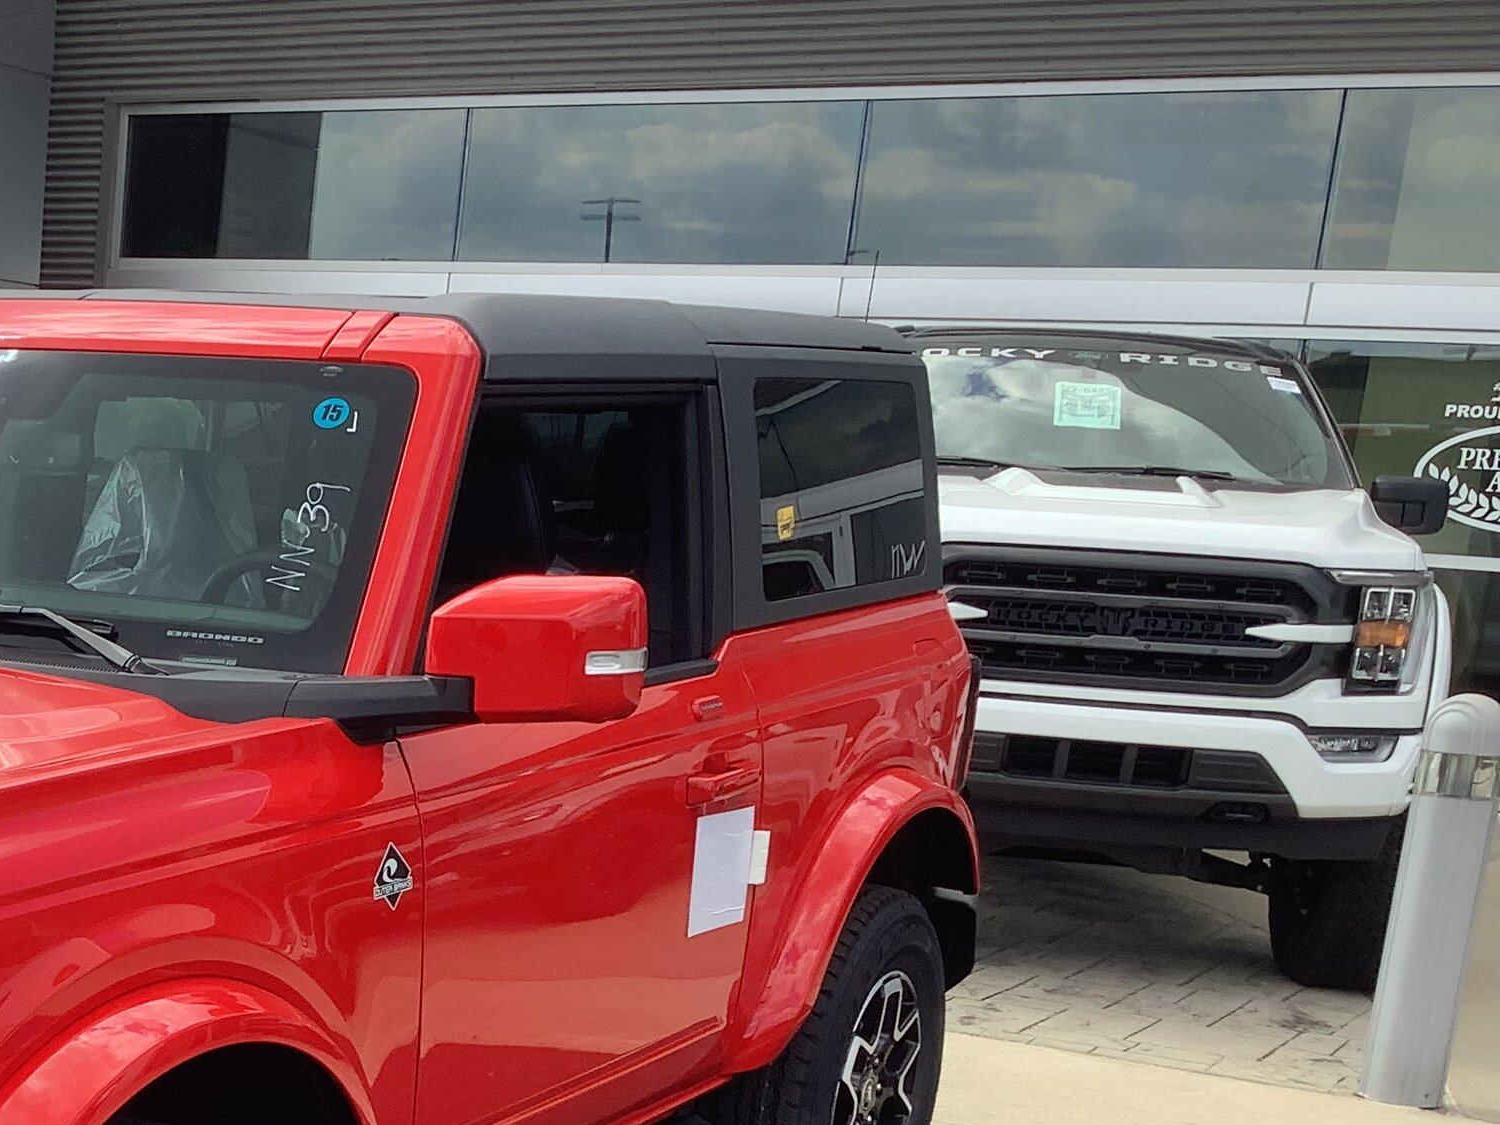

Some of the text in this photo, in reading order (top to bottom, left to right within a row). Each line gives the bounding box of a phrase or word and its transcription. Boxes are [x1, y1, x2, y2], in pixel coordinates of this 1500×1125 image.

[922, 347, 1057, 360] OCKY
[1119, 352, 1284, 377] RIDGE
[321, 404, 344, 422] 15
[1444, 404, 1500, 419] PROU
[166, 630, 264, 644] BRONCO
